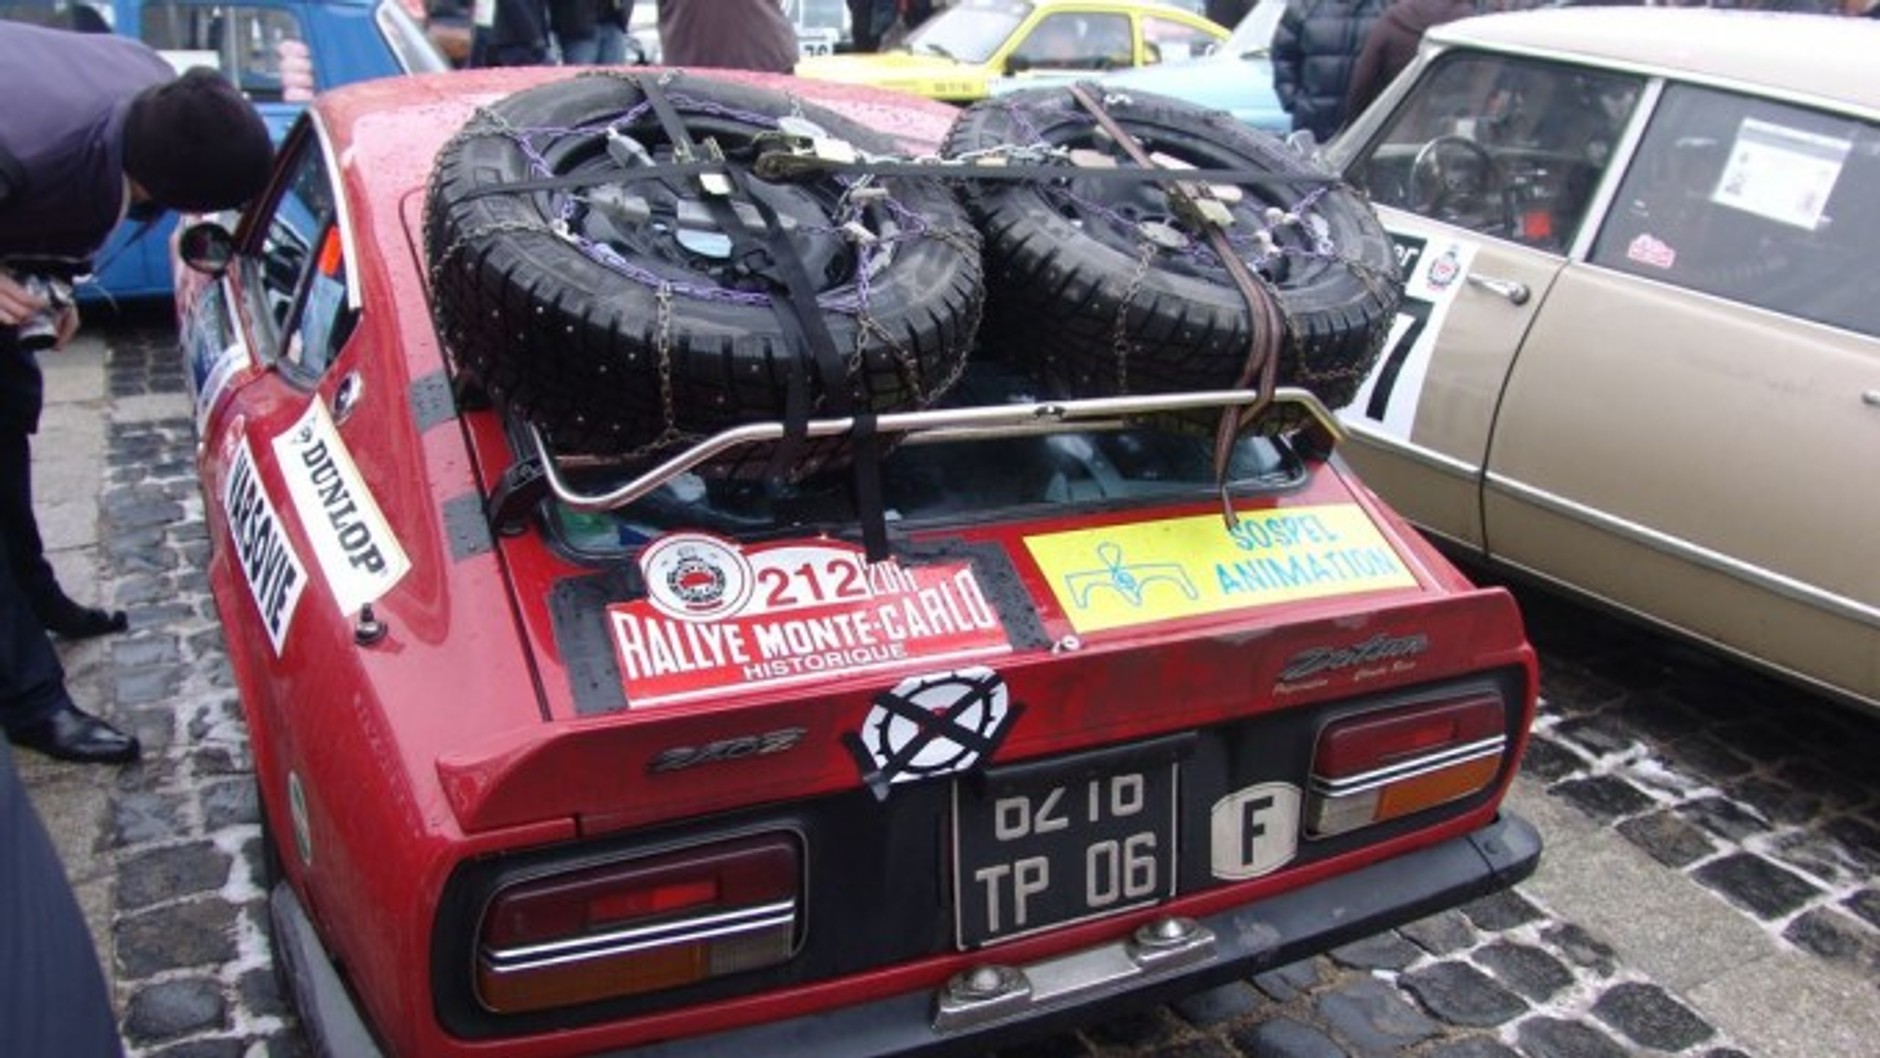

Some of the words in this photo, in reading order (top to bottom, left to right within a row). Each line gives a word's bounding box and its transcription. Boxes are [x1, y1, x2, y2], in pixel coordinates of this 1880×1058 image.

[301, 439, 386, 574] DUNLOP
[1231, 514, 1338, 552] SOSPEL
[229, 450, 297, 637] VARSOVIE
[1215, 547, 1398, 596] ANIMATION
[757, 558, 867, 607] 212
[613, 611, 749, 679] RALLYE
[753, 570, 993, 658] MONTE-CARLO
[744, 643, 907, 681] HISTORIQUE
[1240, 795, 1273, 867] F
[975, 856, 1049, 932] TP
[1086, 831, 1157, 909] 06
